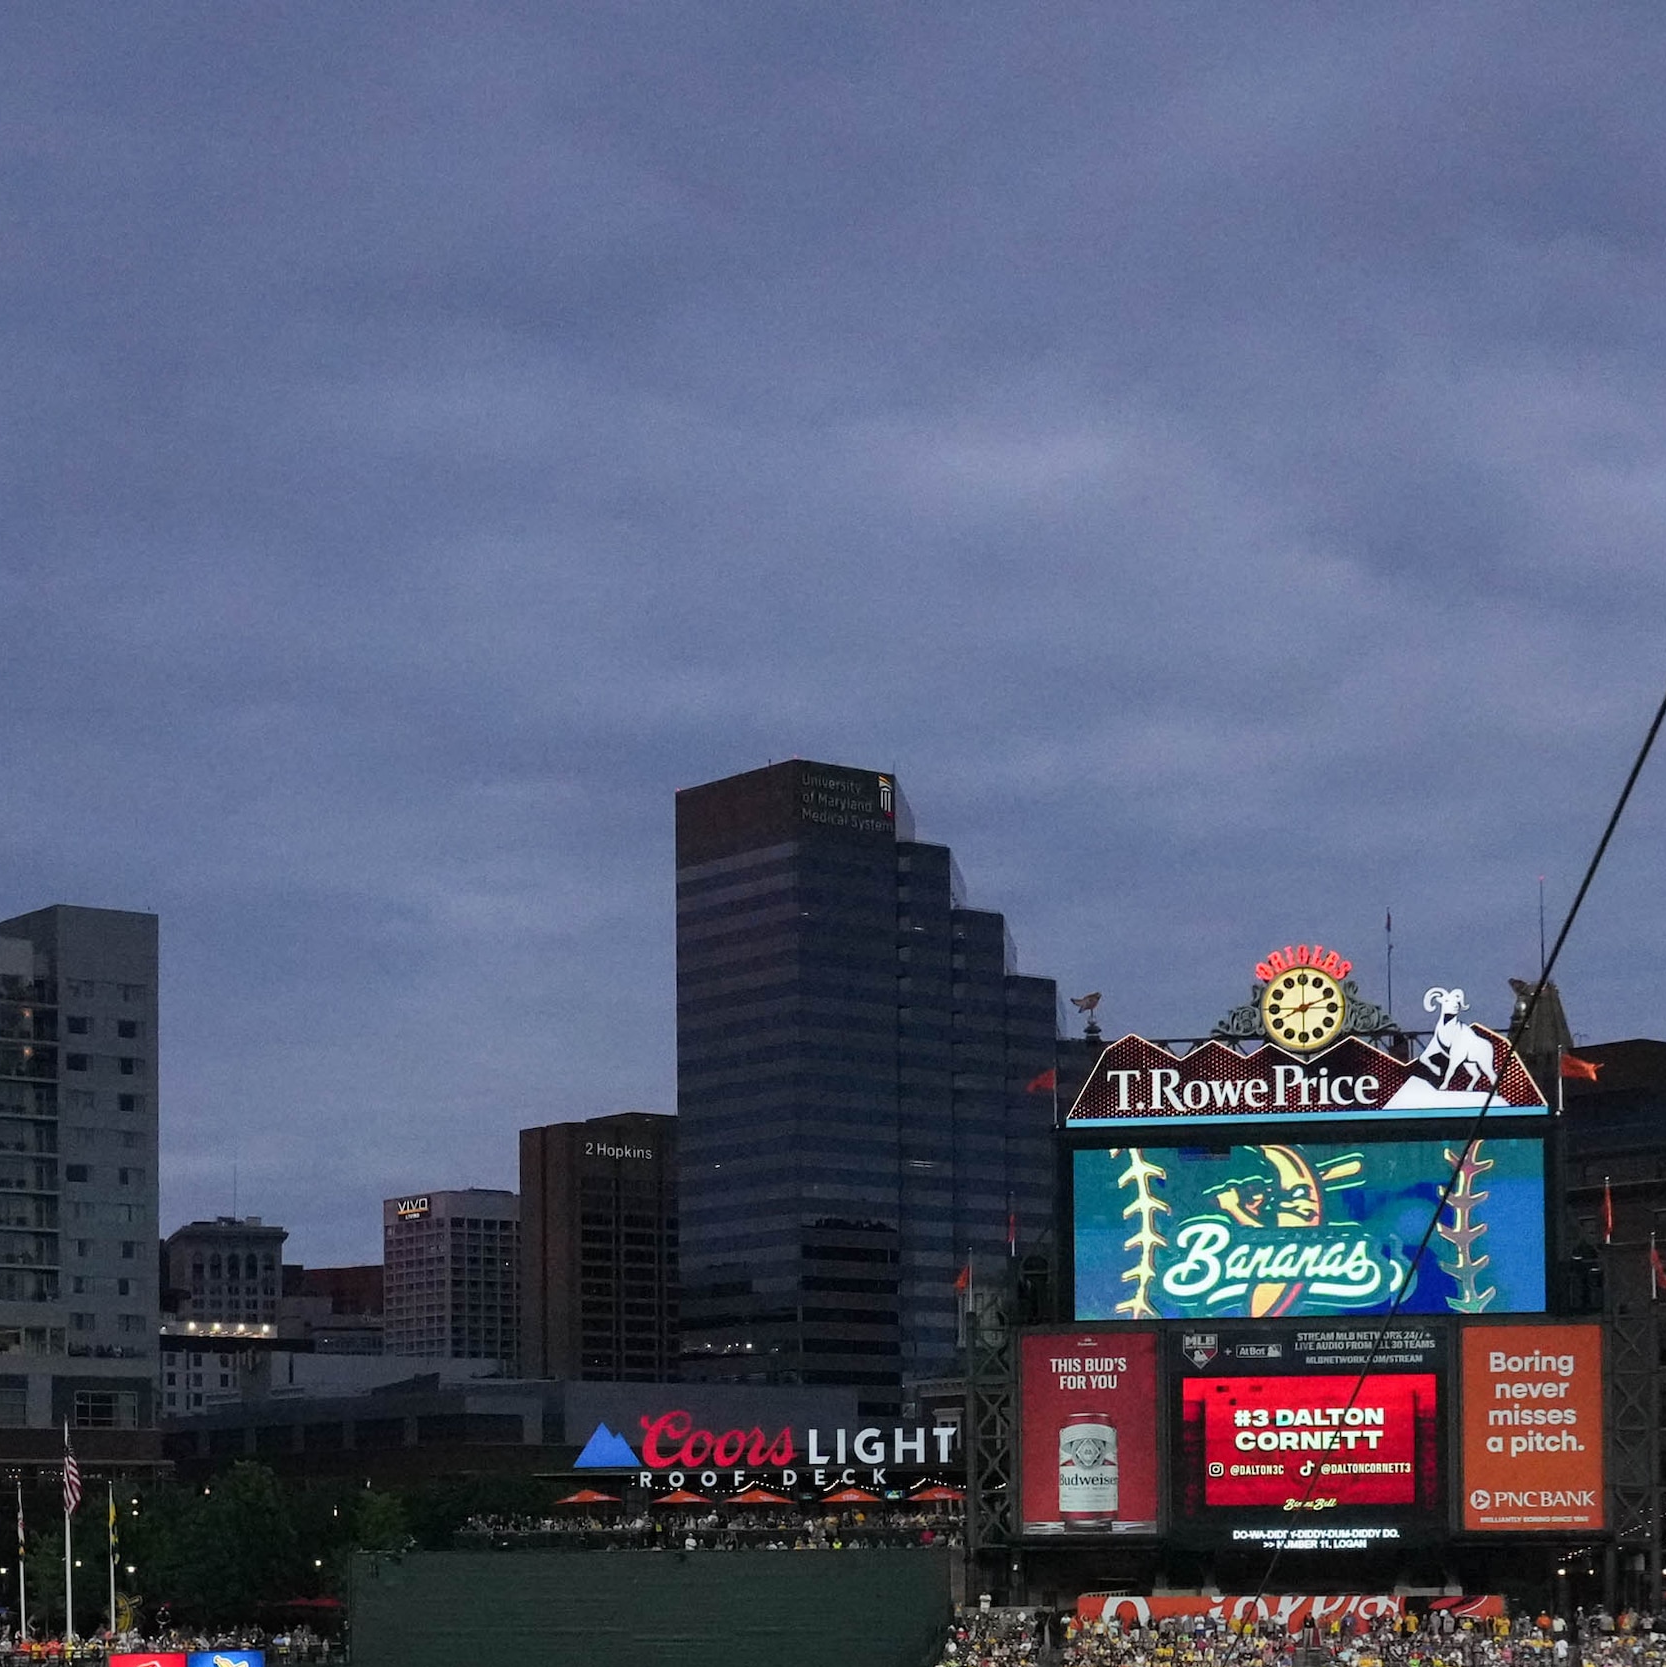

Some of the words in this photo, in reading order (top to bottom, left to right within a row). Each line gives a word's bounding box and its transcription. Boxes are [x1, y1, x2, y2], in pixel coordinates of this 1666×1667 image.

[802, 774, 861, 795] University
[802, 791, 814, 804] of
[818, 792, 873, 815] Maryland
[802, 808, 848, 826] Medical
[851, 816, 895, 833] System
[1255, 945, 1353, 981] ORIOLES
[585, 1143, 593, 1156] 2
[596, 1143, 653, 1160] Hopkins
[1163, 1223, 1381, 1297] Bananas
[1295, 1341, 1315, 1351] LIVE
[1316, 1341, 1344, 1350] AUDIO
[1345, 1341, 1372, 1350] FROM
[1391, 1340, 1403, 1349] 30
[1404, 1340, 1436, 1349] TEAMS
[1296, 1332, 1334, 1342] STREAM
[1335, 1332, 1355, 1341] MLB
[1049, 1358, 1081, 1374] THIS
[1084, 1357, 1127, 1373] BUD'S
[1489, 1350, 1574, 1377] Boring
[1059, 1375, 1086, 1390] FOR
[1089, 1374, 1118, 1390] YOU
[1495, 1381, 1570, 1399] never
[1234, 1408, 1269, 1427] #3
[1275, 1407, 1385, 1427] DALTON
[1488, 1403, 1577, 1426] misses
[641, 1410, 797, 1468] Coors
[808, 1427, 957, 1464] LIGHT
[1234, 1430, 1384, 1451] CORNETT
[1486, 1435, 1504, 1453] a
[1510, 1429, 1585, 1458] pitch.
[639, 1469, 744, 1488] ROOF
[783, 1467, 886, 1486] DECK
[1230, 1464, 1284, 1476] @DALTON3C
[1321, 1462, 1411, 1475] @DALTONCORNETT3
[1059, 1473, 1118, 1487] Budweiser
[1494, 1491, 1539, 1508] PNC
[1540, 1490, 1596, 1507] BANK
[1382, 1529, 1400, 1539] DO.
[1333, 1540, 1367, 1549] LOGAN
